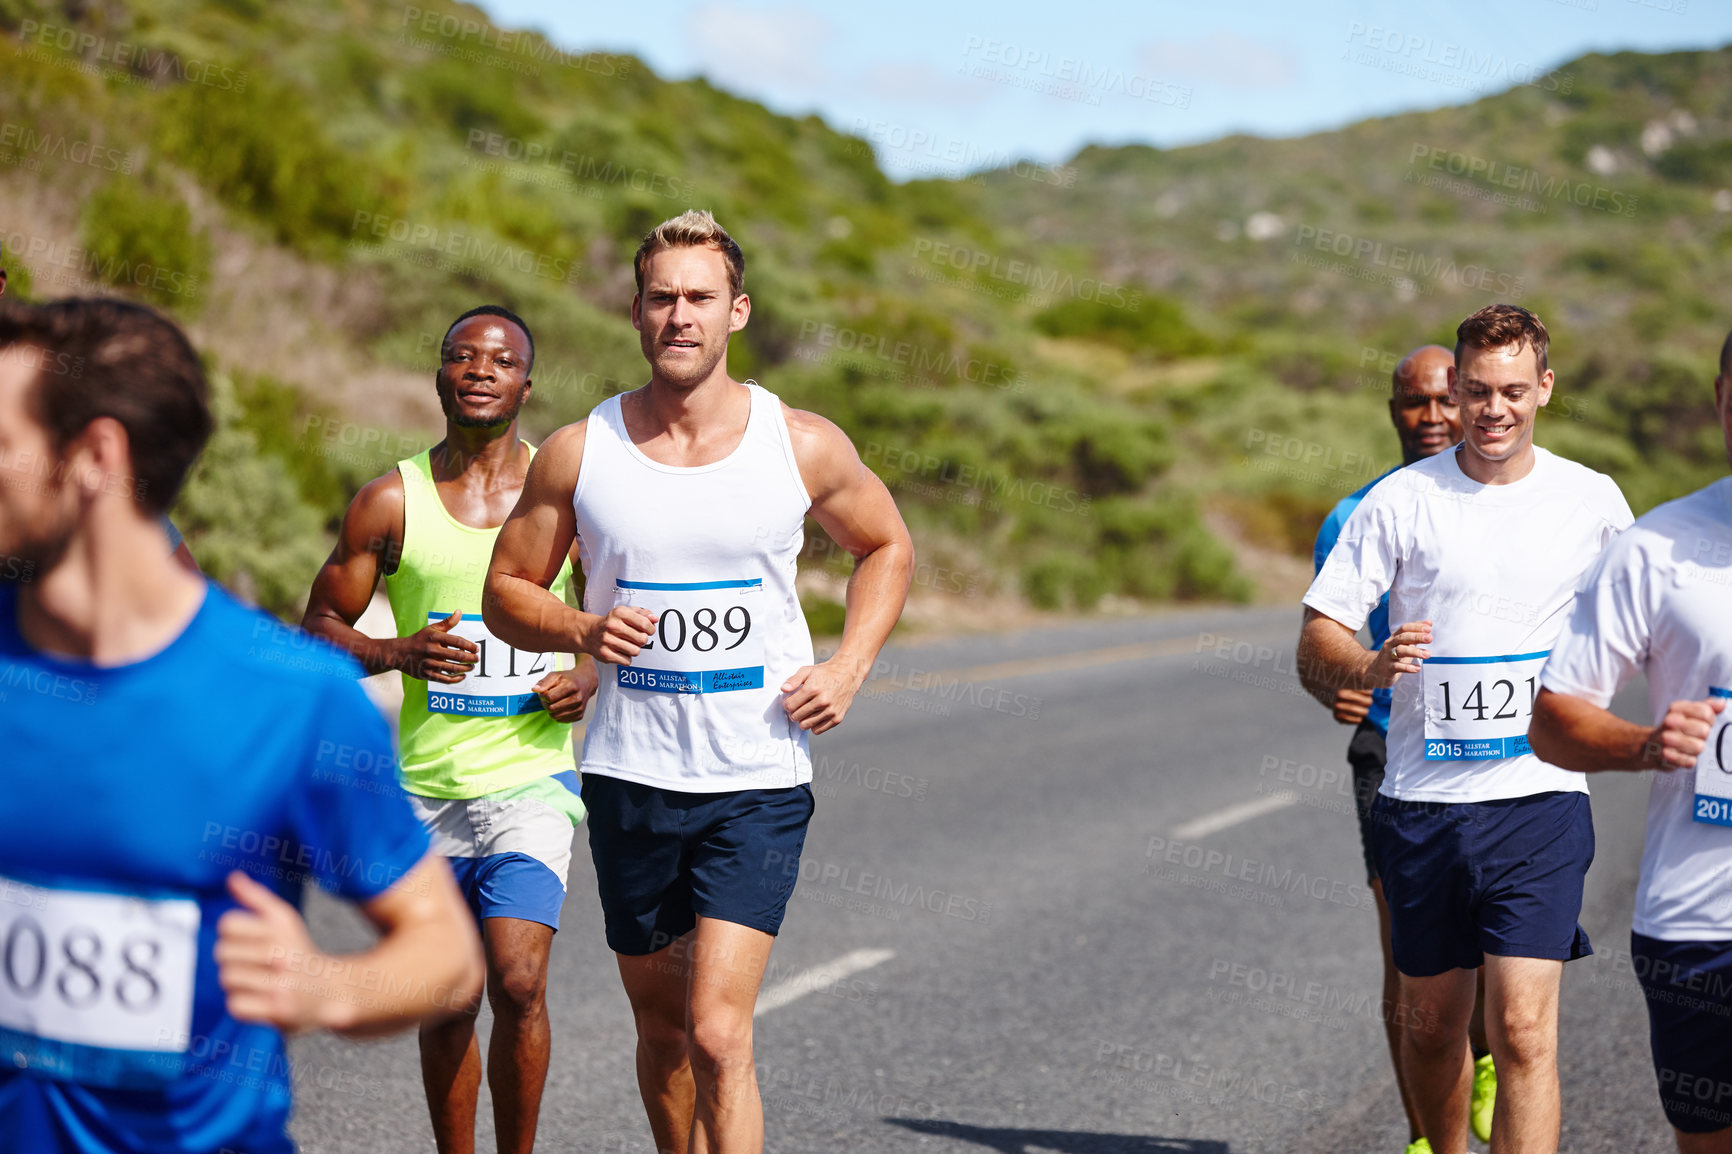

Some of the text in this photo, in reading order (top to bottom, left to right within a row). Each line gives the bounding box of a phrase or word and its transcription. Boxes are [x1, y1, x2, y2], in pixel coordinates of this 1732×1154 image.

[640, 606, 751, 652] 089
[620, 670, 656, 687] 2015
[713, 680, 753, 690] Enterprises
[430, 695, 465, 711] 2015
[1438, 676, 1535, 721] 1421
[1427, 743, 1462, 757] 2015
[1464, 749, 1500, 757] MARATHON
[1697, 799, 1732, 820] 201
